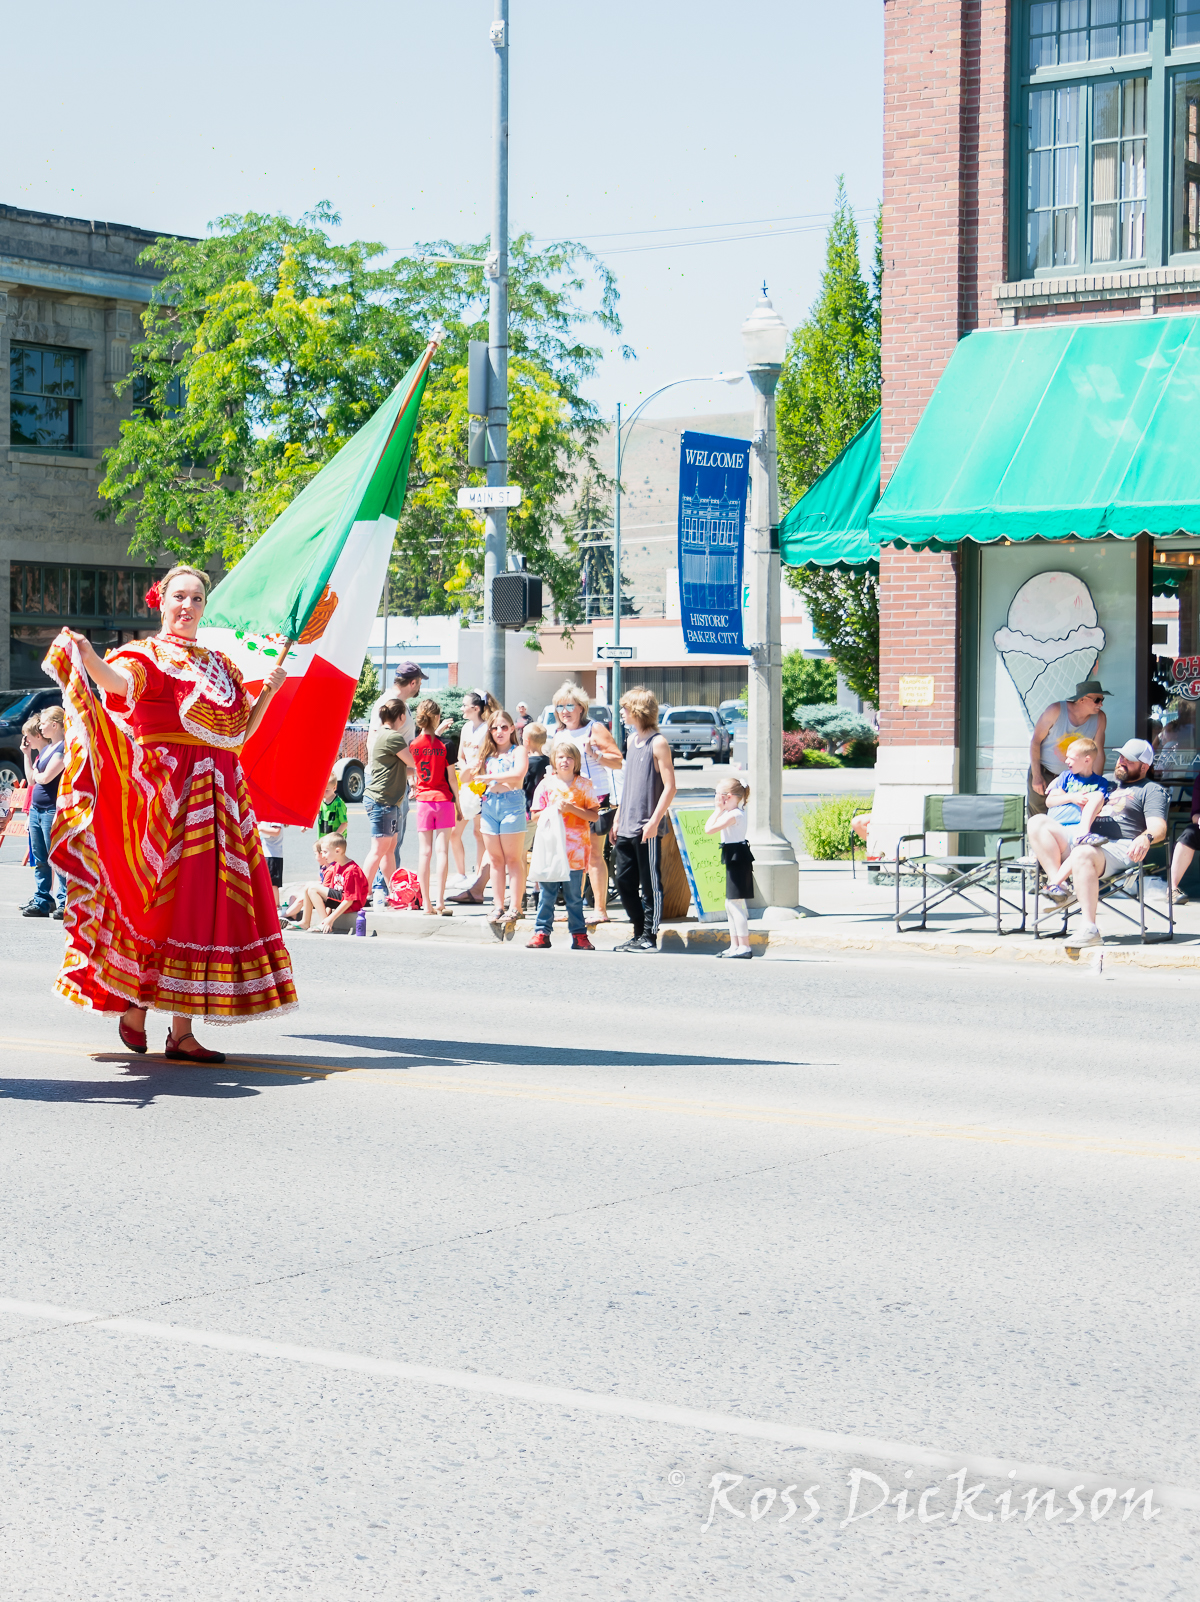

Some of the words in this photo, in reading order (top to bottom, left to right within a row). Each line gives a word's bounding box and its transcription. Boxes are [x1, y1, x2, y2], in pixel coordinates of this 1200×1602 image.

[685, 448, 744, 469] WELCOME
[469, 492, 493, 503] MAIN
[498, 491, 510, 503] ST
[690, 613, 729, 628] HISTORIC
[687, 629, 717, 644] BAKER
[718, 631, 739, 645] CITY
[421, 761, 432, 782] 5
